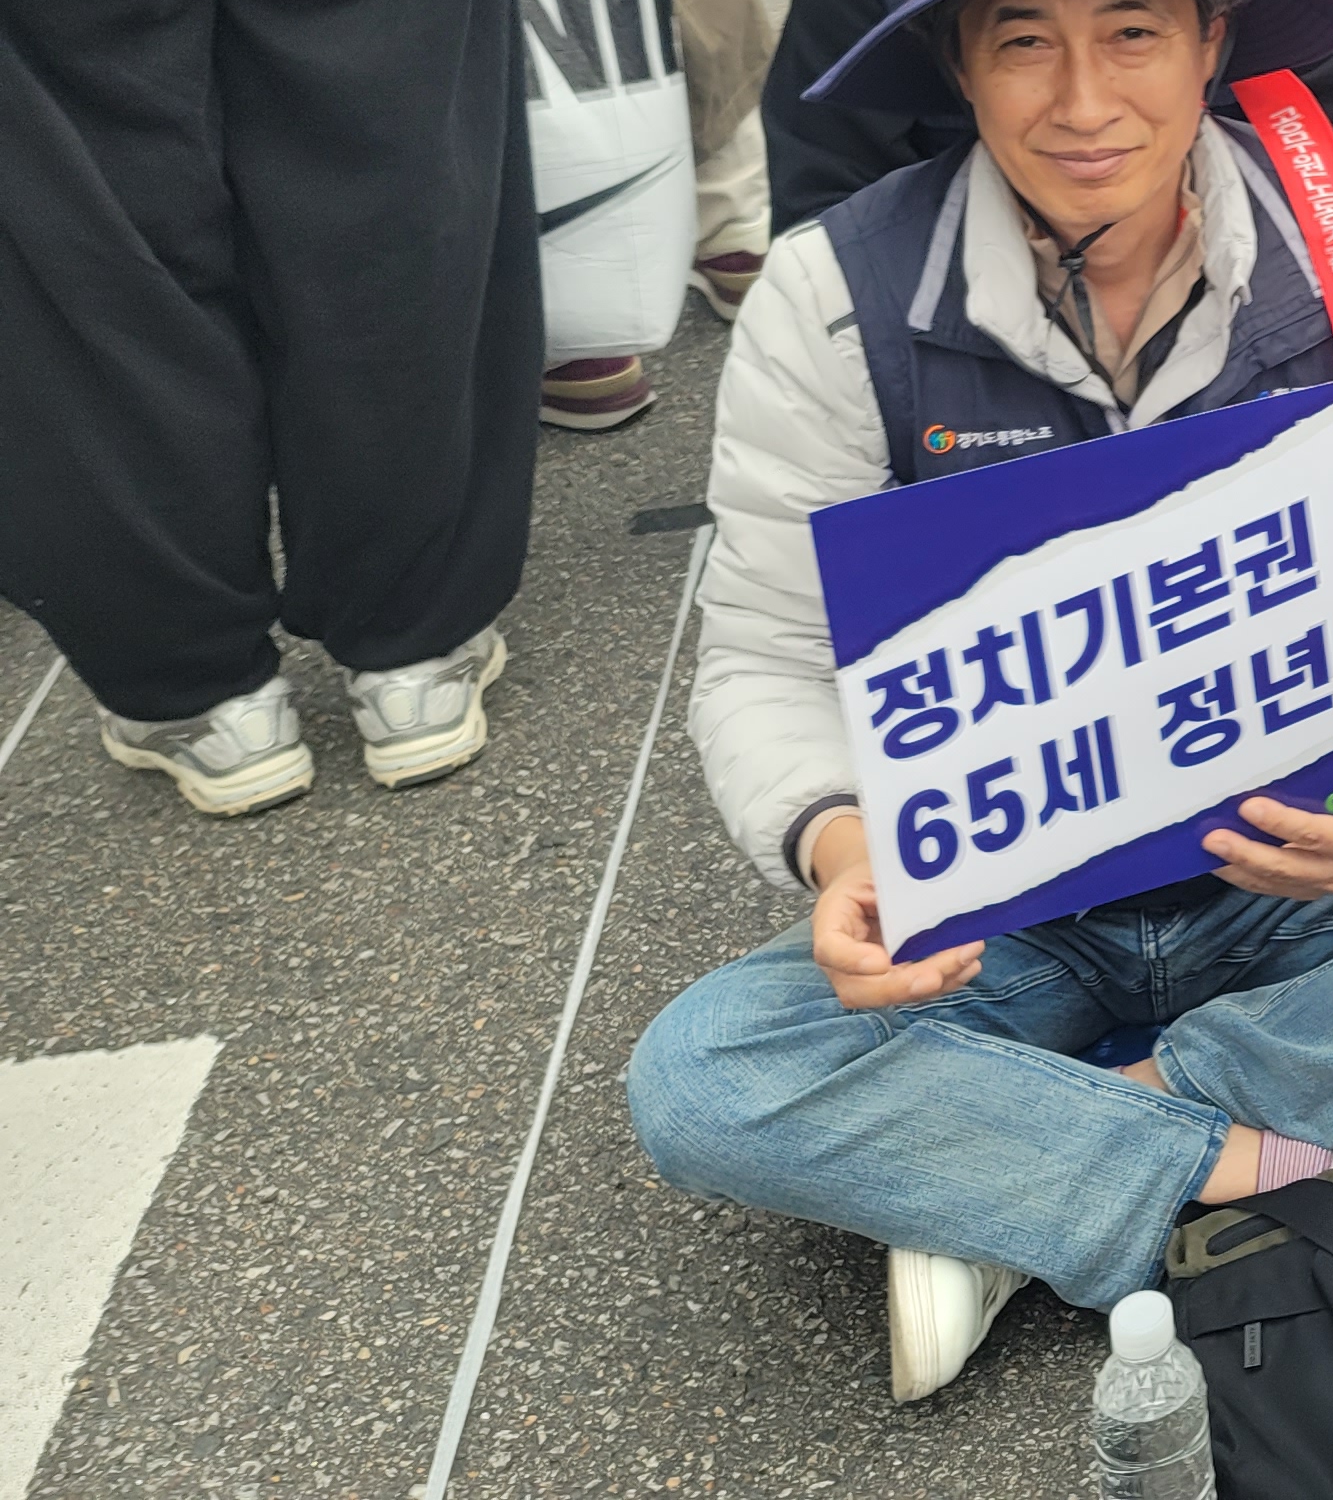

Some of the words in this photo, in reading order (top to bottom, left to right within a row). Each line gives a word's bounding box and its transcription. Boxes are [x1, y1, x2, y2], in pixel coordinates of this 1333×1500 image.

[955, 424, 1055, 449] 경기도통합노조
[865, 497, 1320, 763] 정치기본권
[895, 714, 1122, 885] 65세
